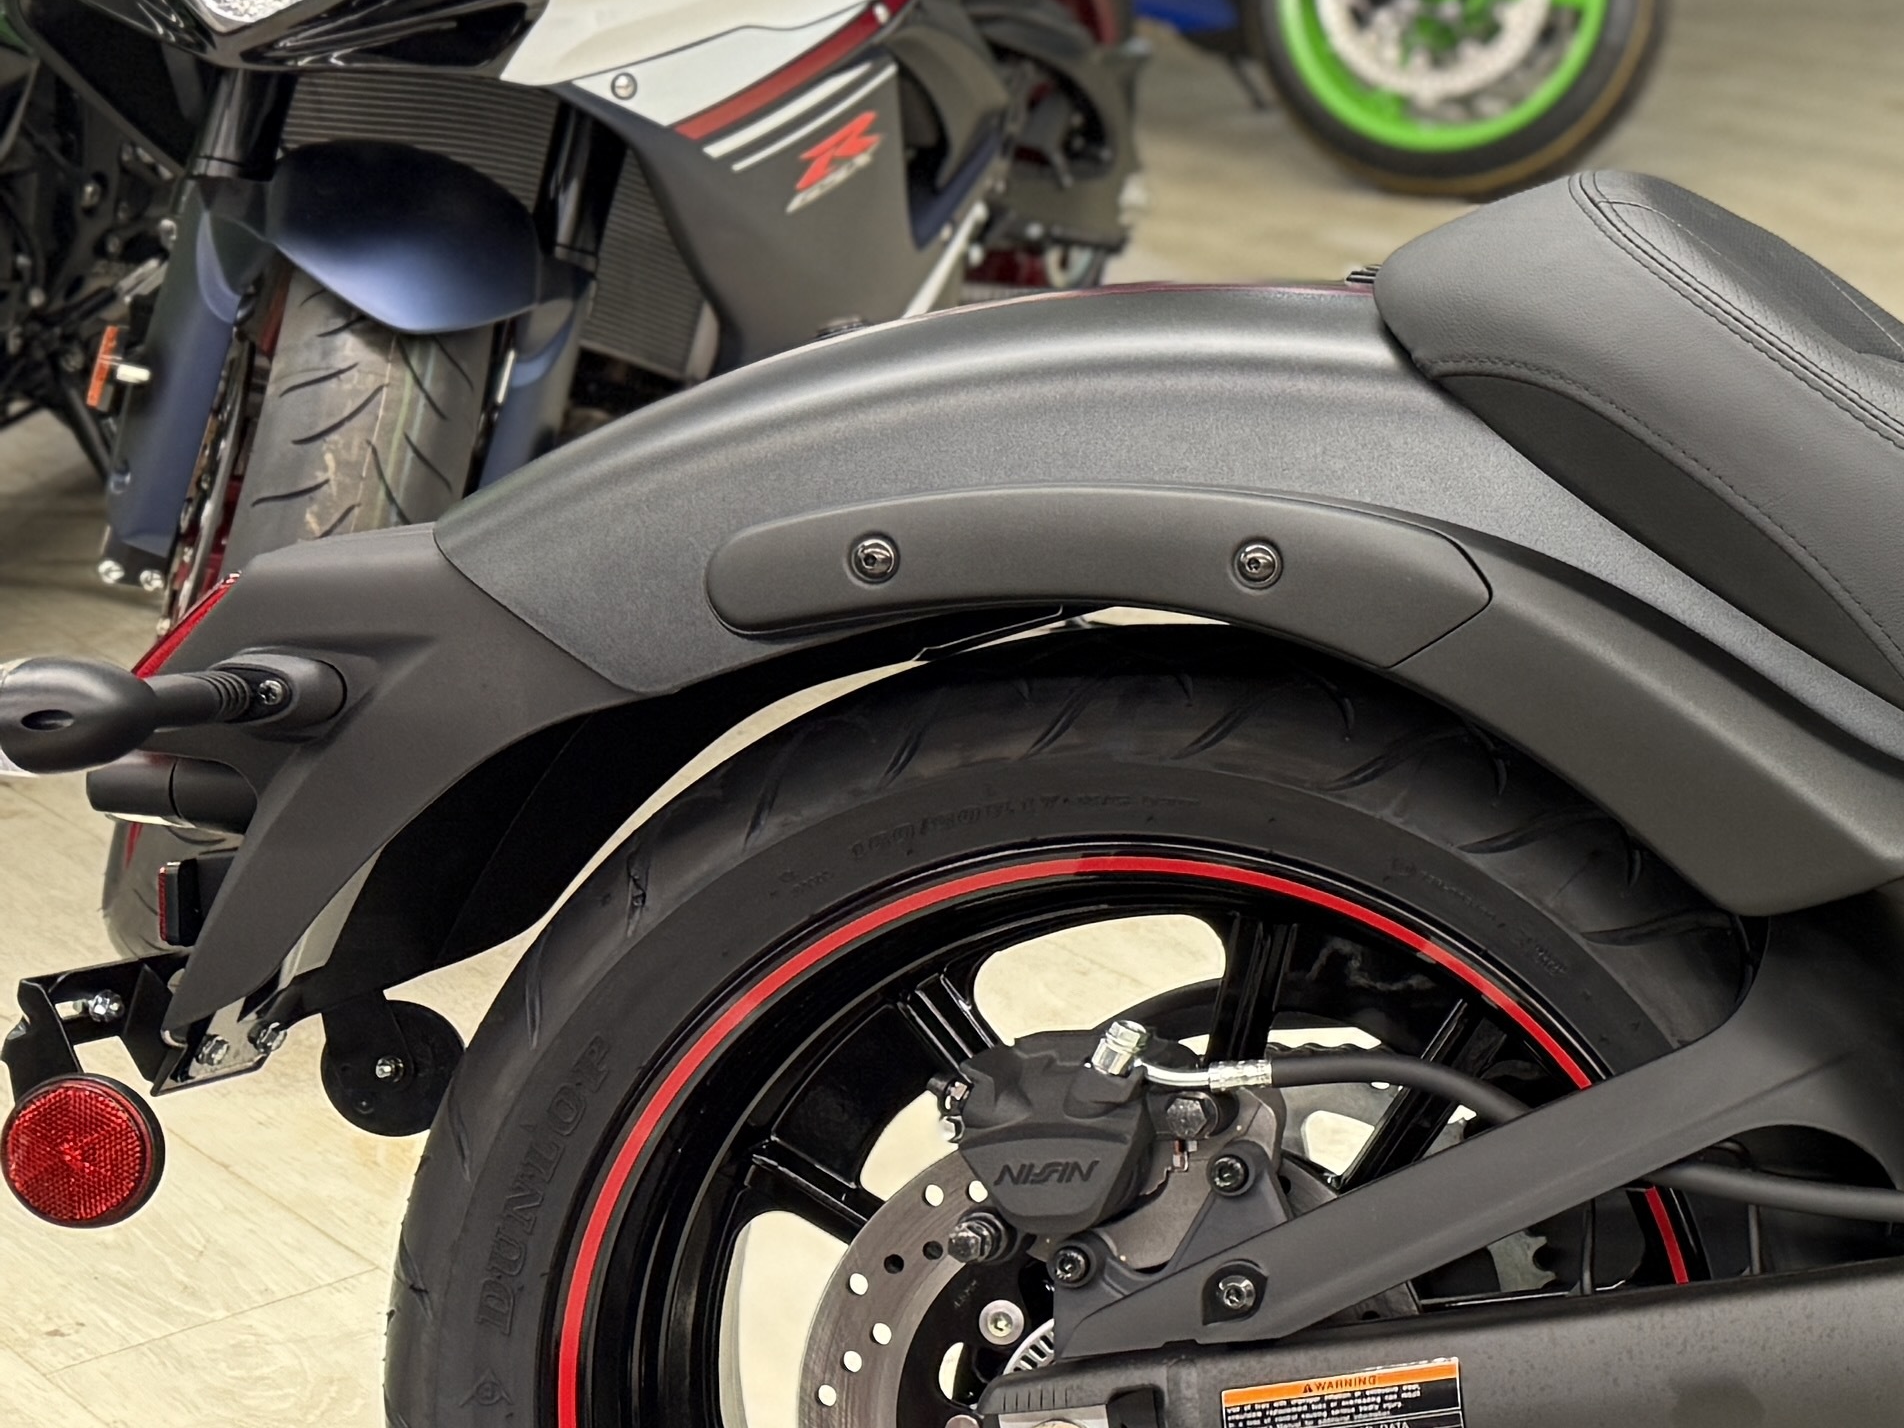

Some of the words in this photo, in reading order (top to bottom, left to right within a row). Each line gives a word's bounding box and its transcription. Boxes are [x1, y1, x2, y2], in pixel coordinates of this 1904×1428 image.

[476, 1033, 617, 1334] DUNLOP
[994, 1160, 1100, 1186] NISSIN
[1314, 1375, 1377, 1393] WARNING
